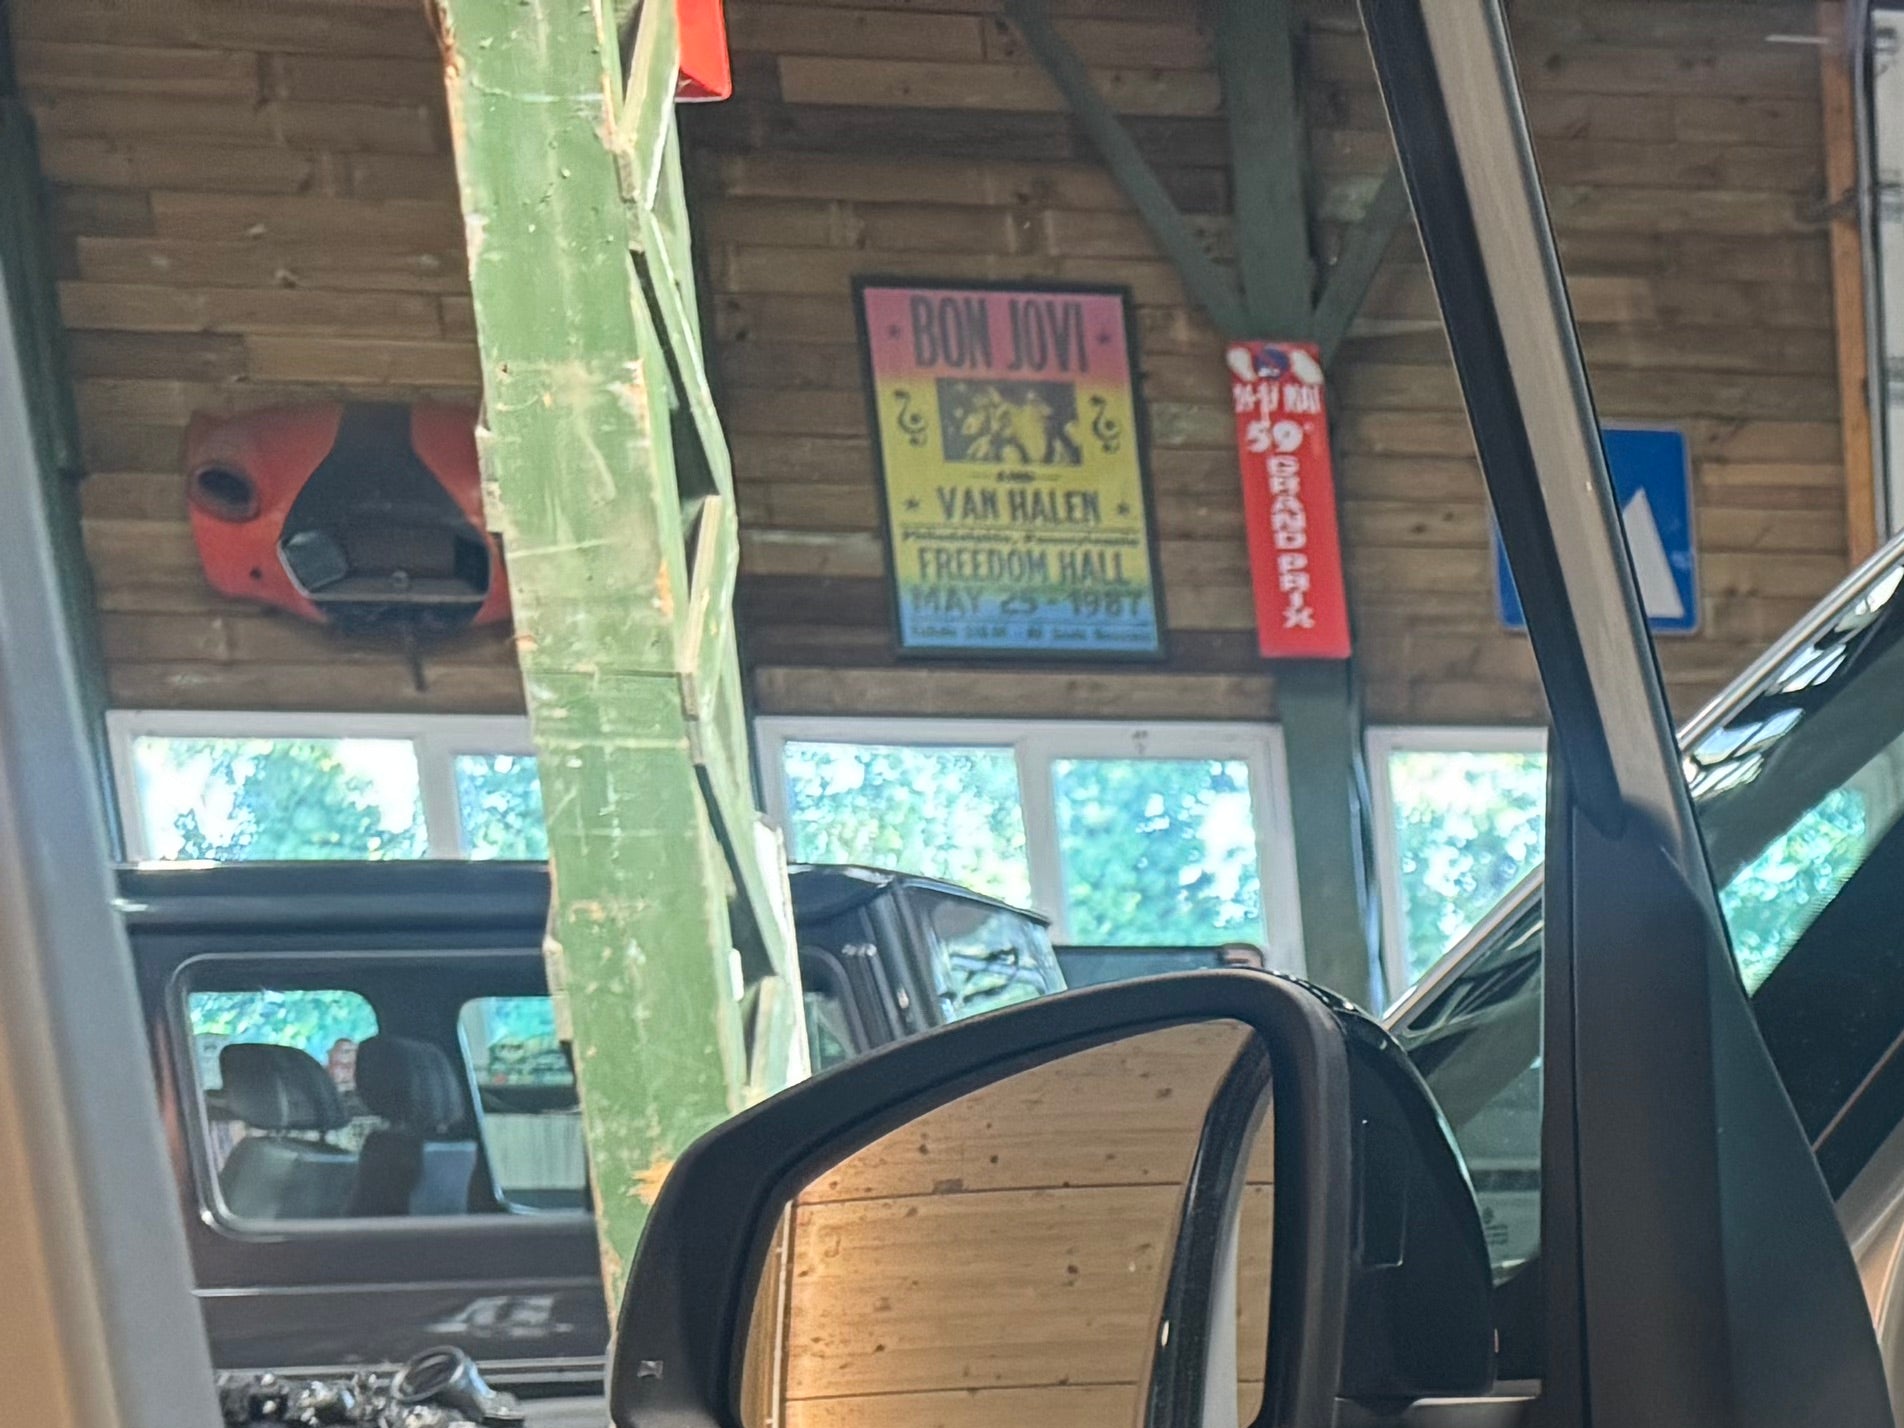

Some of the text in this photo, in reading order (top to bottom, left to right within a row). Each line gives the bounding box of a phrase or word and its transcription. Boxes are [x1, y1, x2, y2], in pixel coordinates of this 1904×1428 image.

[910, 296, 1090, 374] BON JOVI
[936, 486, 1102, 525] VAN HALEN
[1265, 454, 1316, 629] GRAND PRIX
[917, 546, 1132, 588] FREEDOM HALL
[909, 584, 984, 616] MAY
